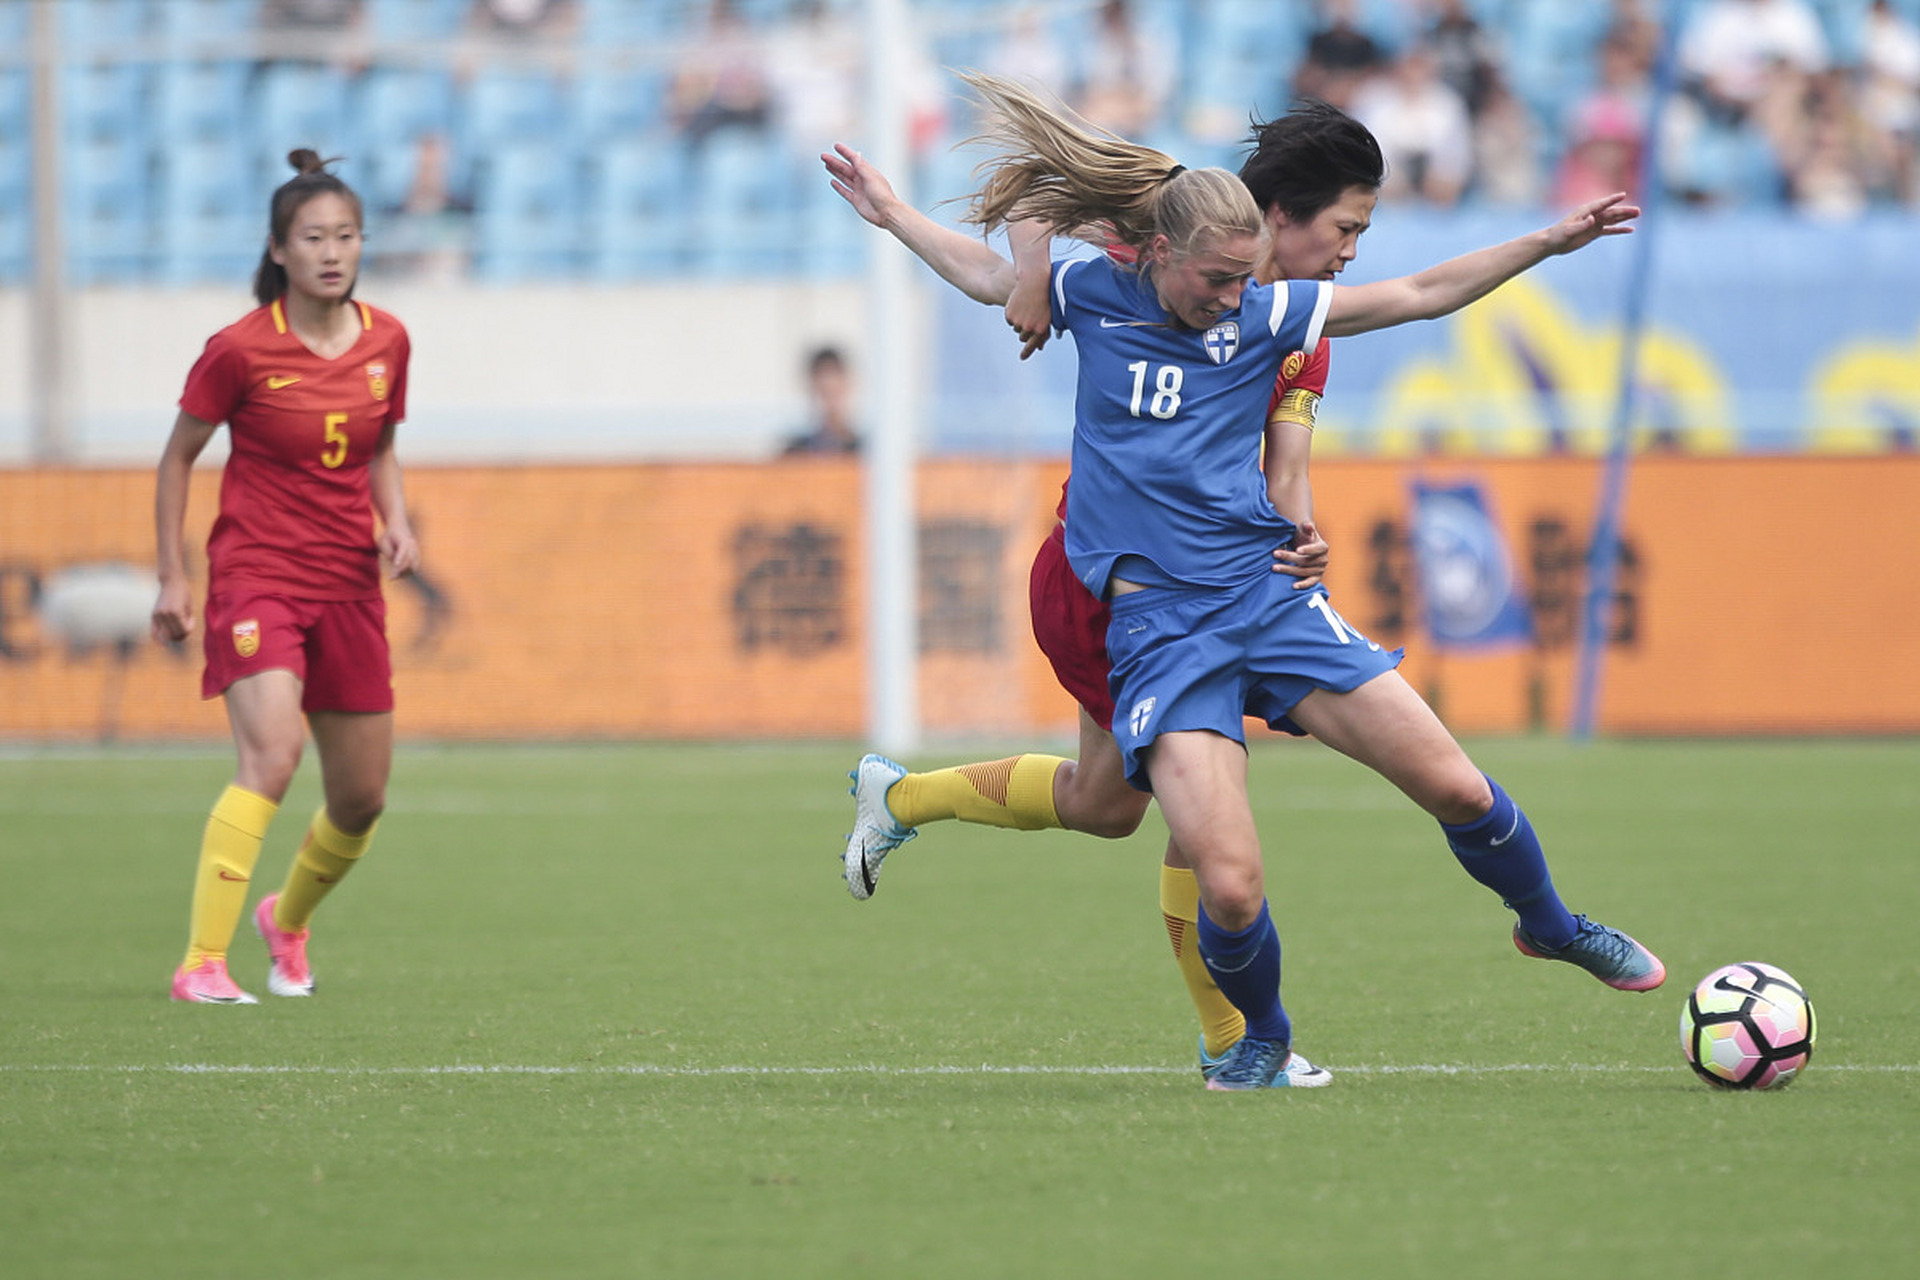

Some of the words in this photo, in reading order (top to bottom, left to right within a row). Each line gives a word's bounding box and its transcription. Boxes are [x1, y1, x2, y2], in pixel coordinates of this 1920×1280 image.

[1128, 360, 1184, 420] 18
[321, 412, 349, 469] 5
[1307, 592, 1380, 652] 1
